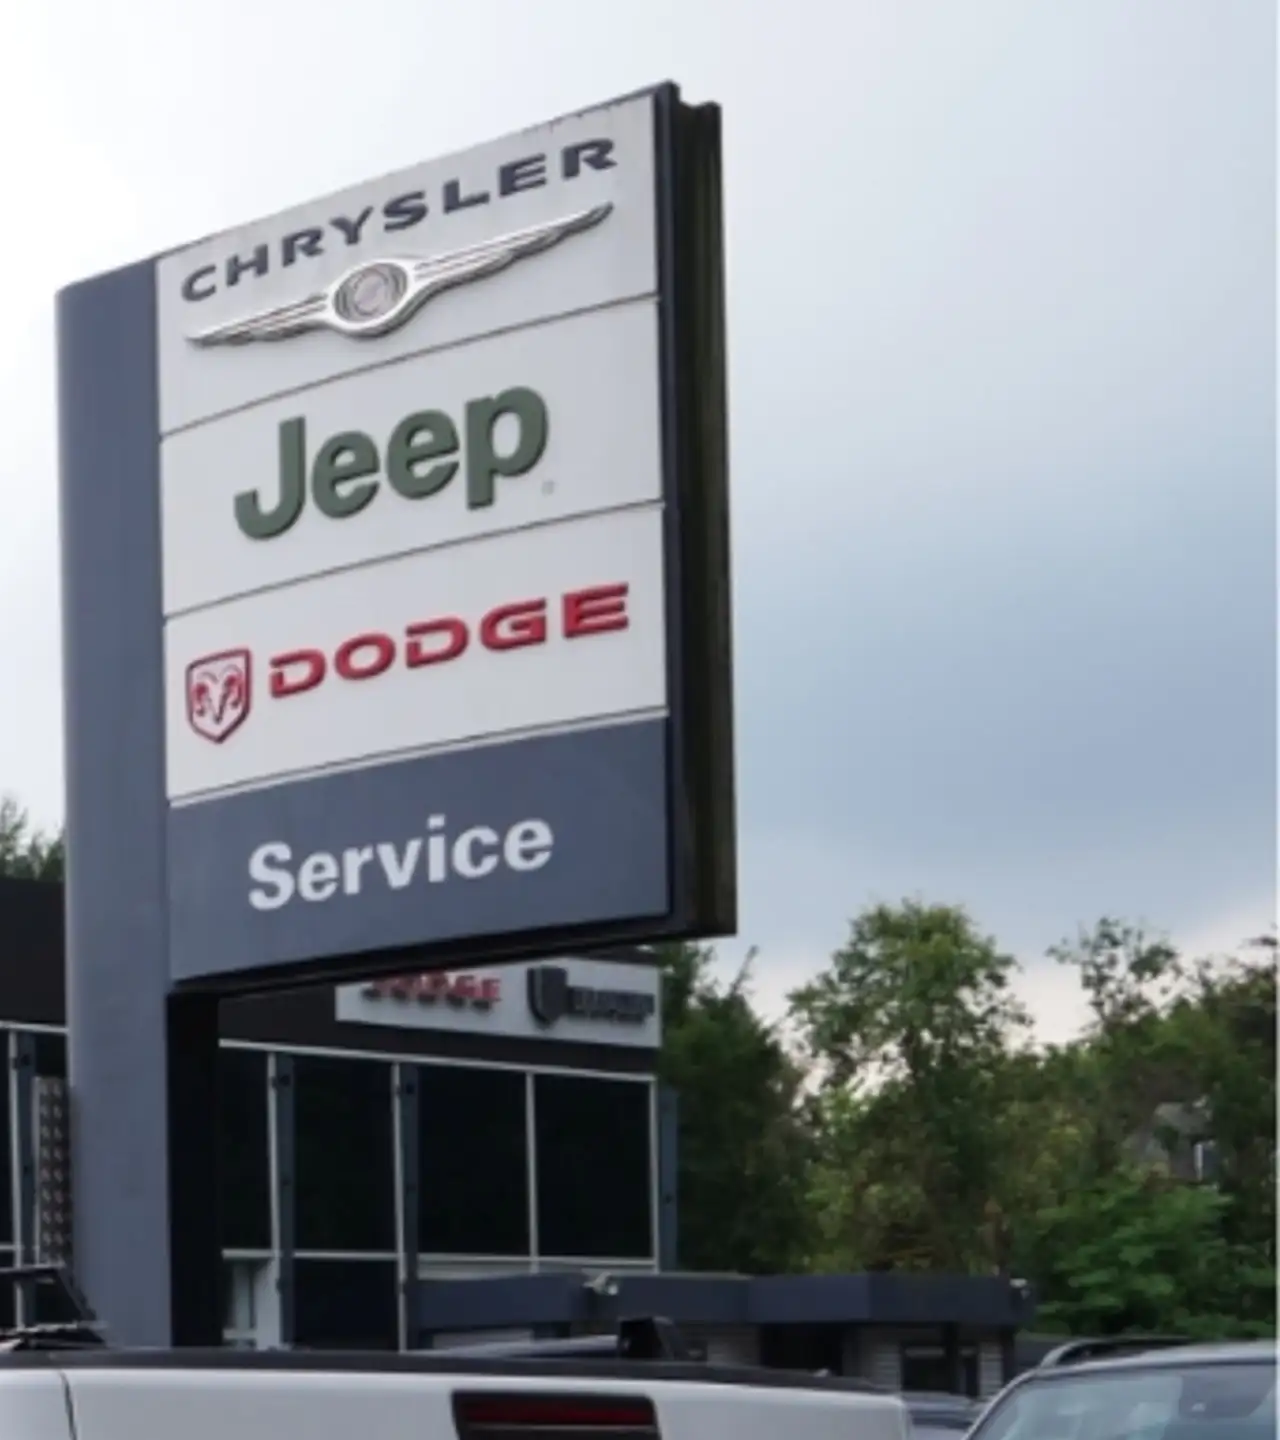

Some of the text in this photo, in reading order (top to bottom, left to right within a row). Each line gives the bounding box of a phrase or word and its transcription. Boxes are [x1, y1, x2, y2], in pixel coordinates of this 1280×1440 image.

[181, 137, 618, 303] CHRYSLER
[233, 385, 548, 541] Jeep
[269, 582, 630, 698] DODGE
[247, 815, 554, 911] Service
